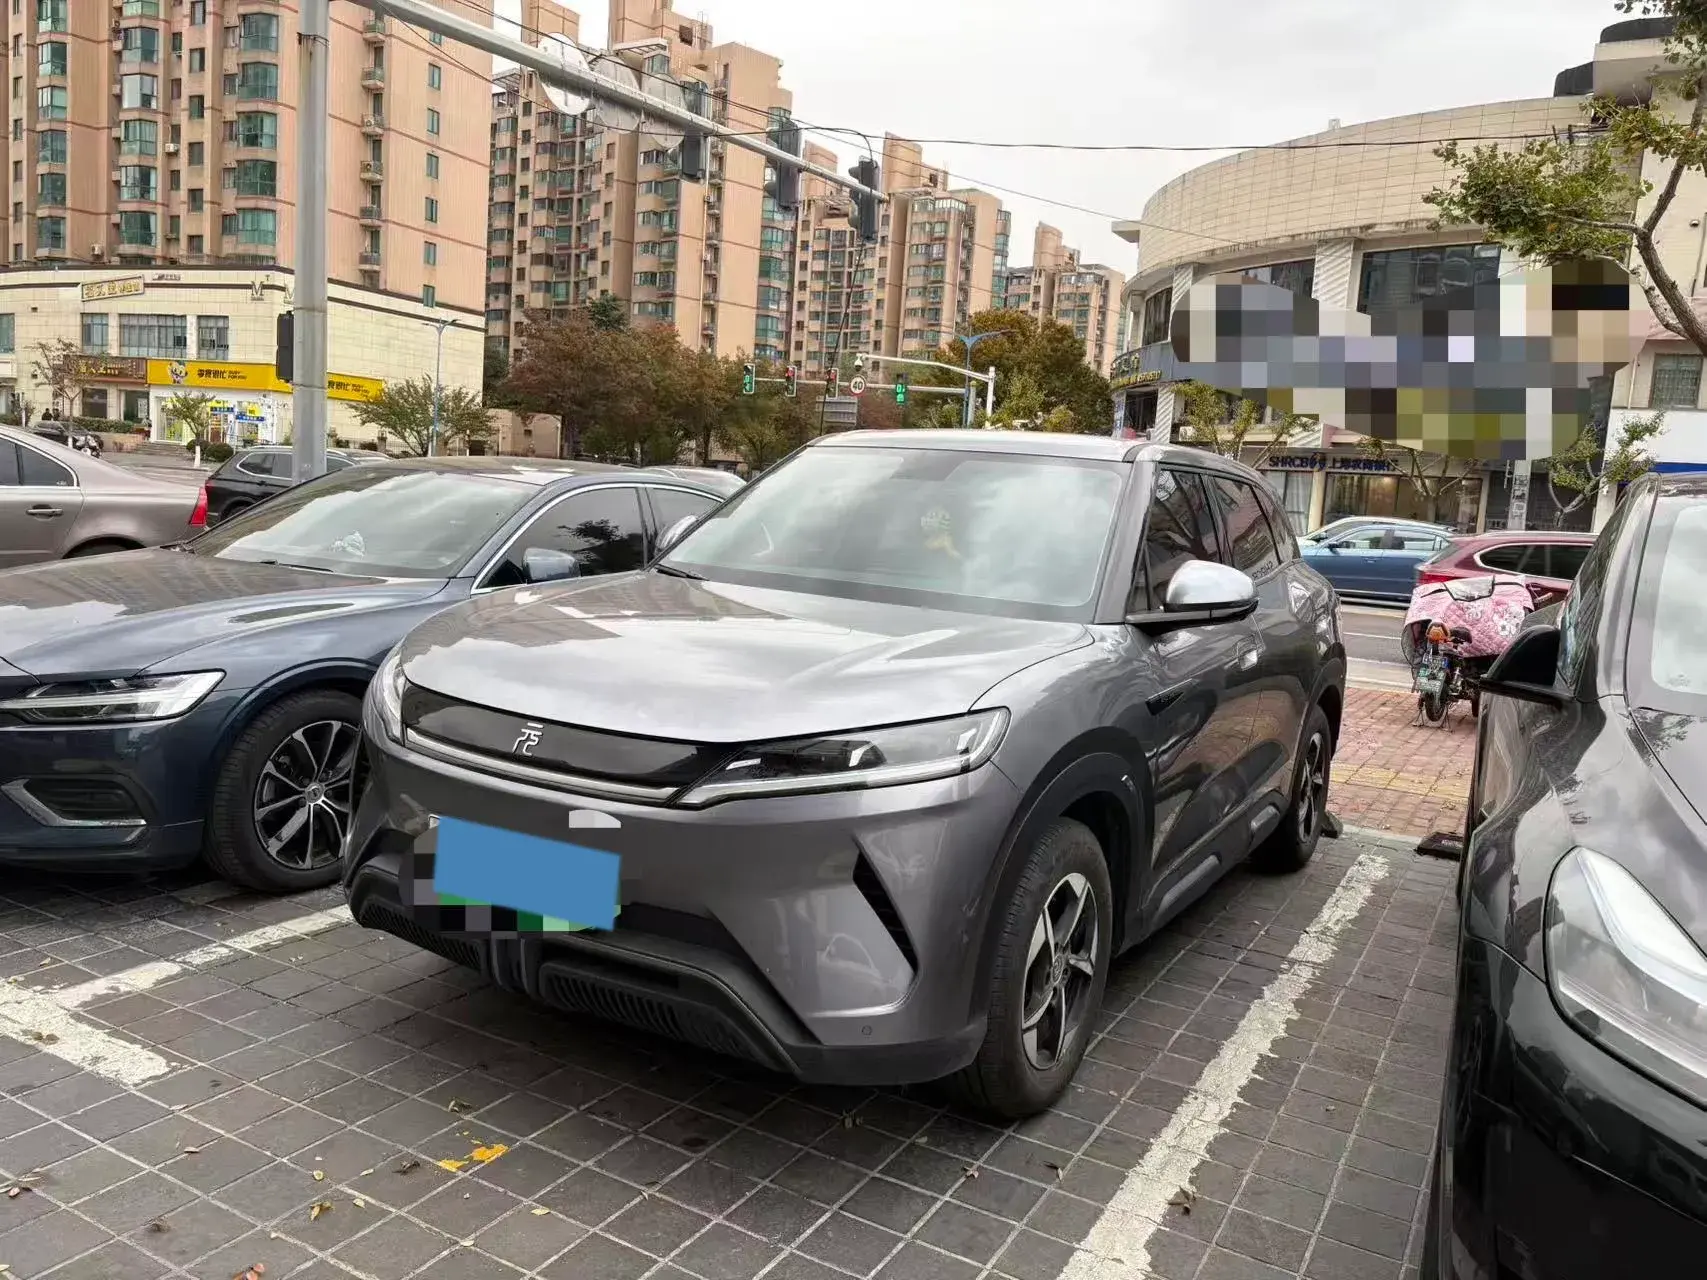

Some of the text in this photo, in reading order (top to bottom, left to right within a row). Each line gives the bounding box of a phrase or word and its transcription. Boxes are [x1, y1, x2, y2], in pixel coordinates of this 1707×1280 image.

[198, 368, 227, 379] 零食很忙
[853, 381, 863, 390] 40
[1269, 455, 1309, 468] SHRCB
[512, 722, 544, 756] 元
